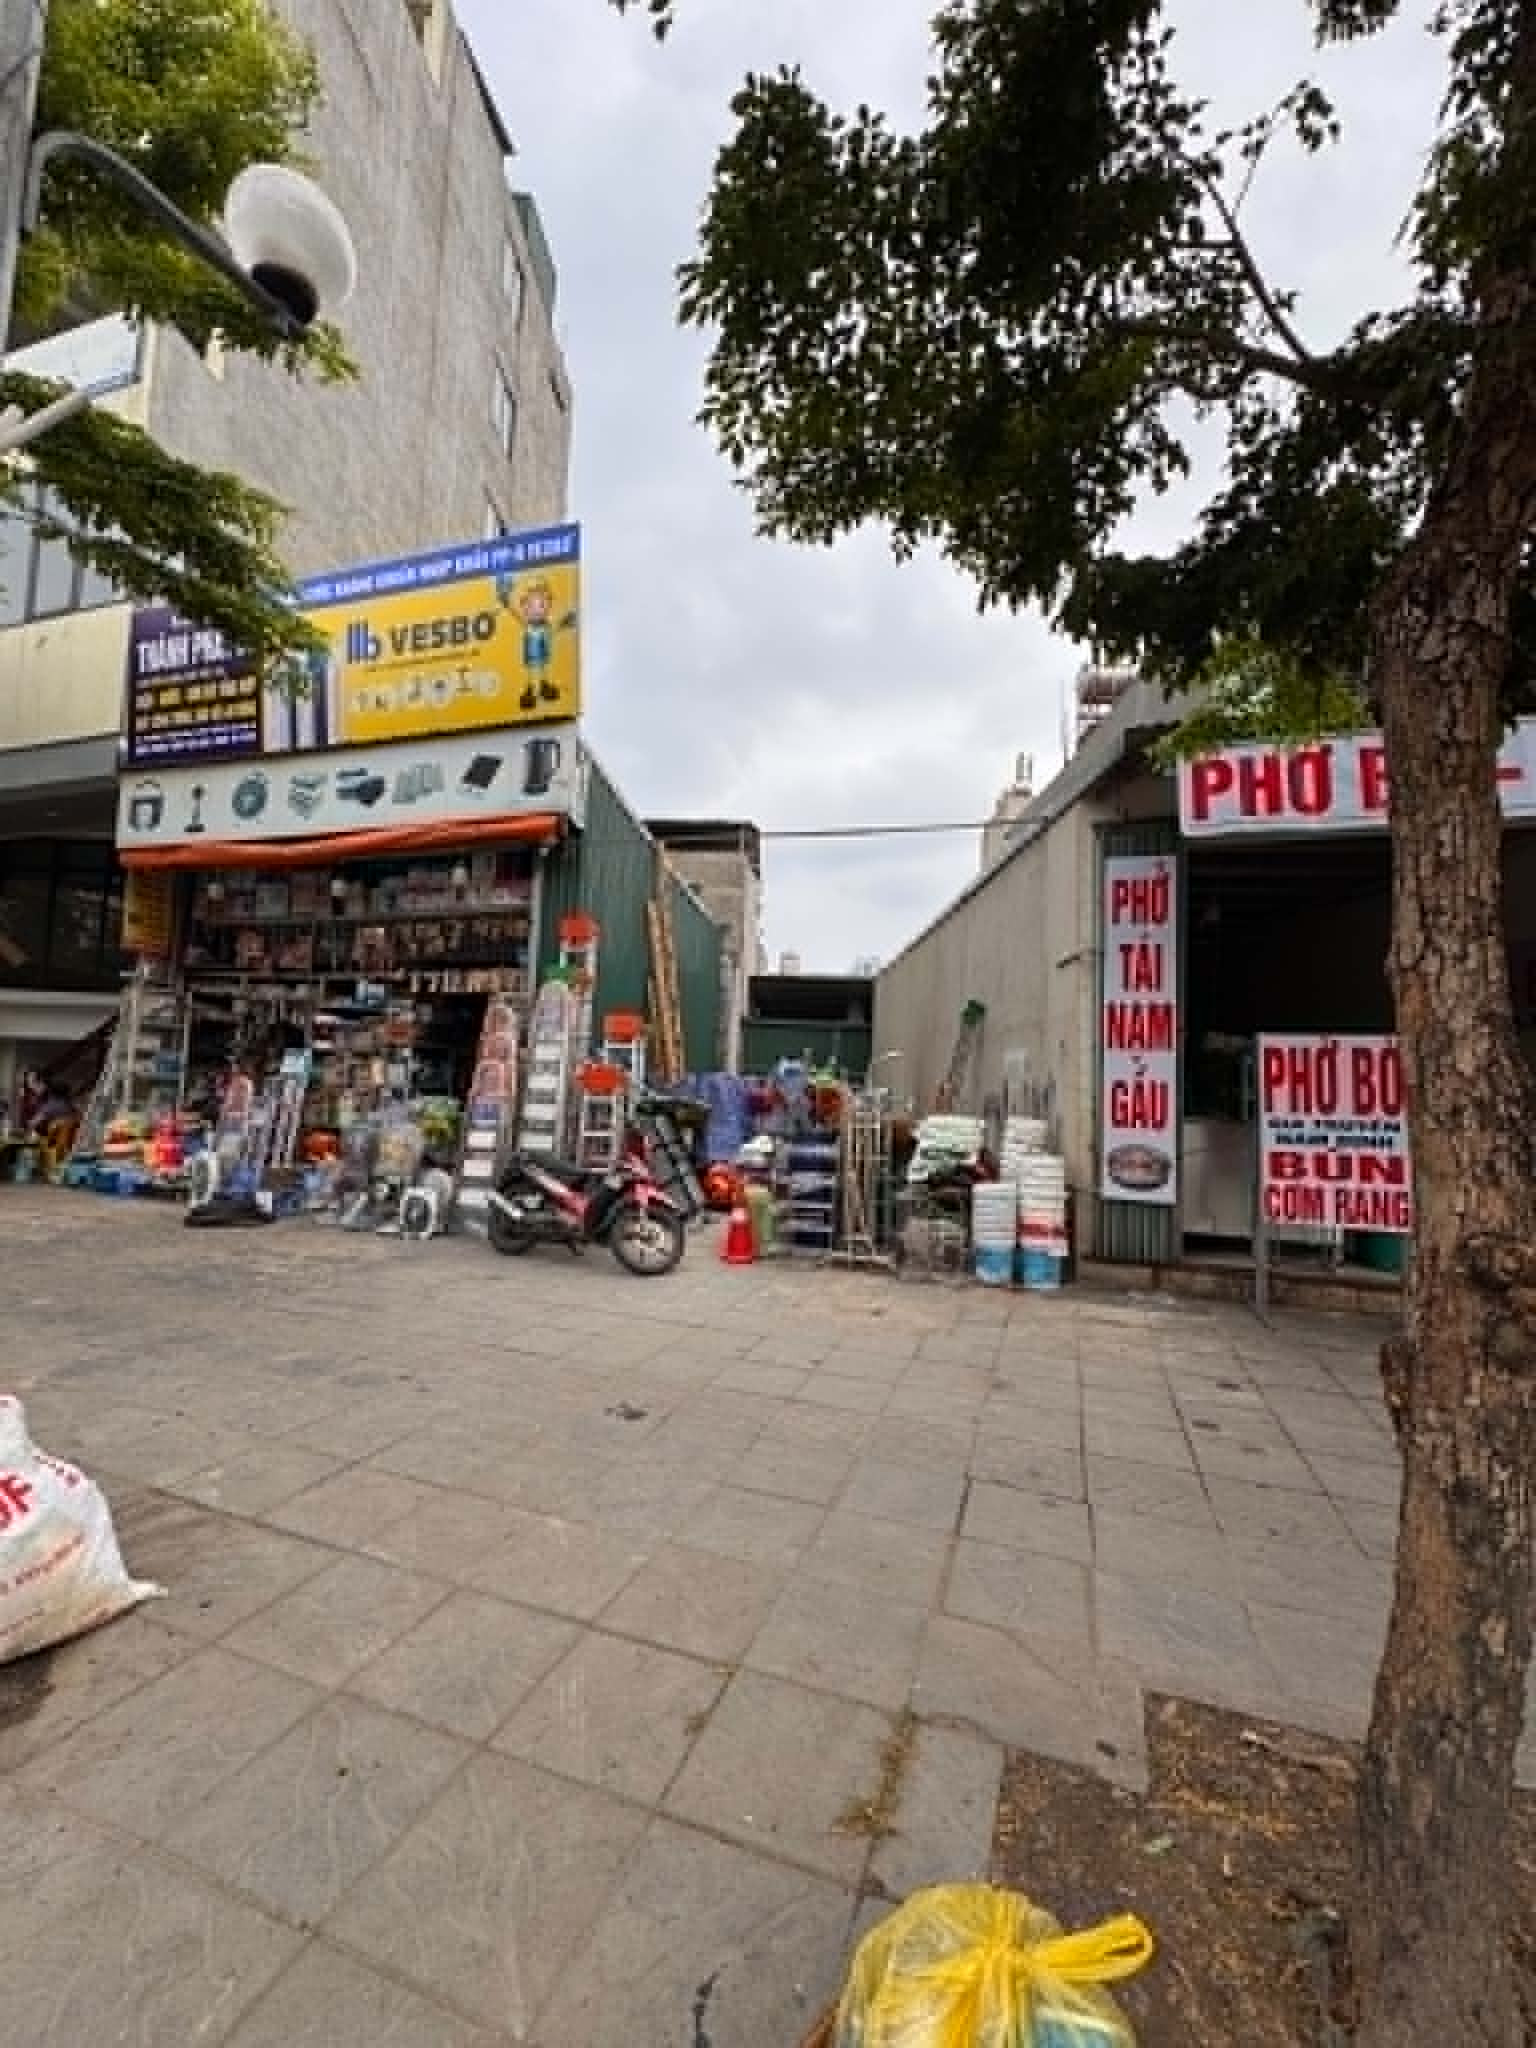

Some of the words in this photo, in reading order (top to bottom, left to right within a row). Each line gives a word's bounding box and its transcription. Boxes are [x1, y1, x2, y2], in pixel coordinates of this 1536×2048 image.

[390, 612, 497, 656] VESBO
[1111, 860, 1170, 926] PHỞ
[1263, 1036, 1339, 1116] PHỞ
[1334, 1187, 1409, 1227] RANG
